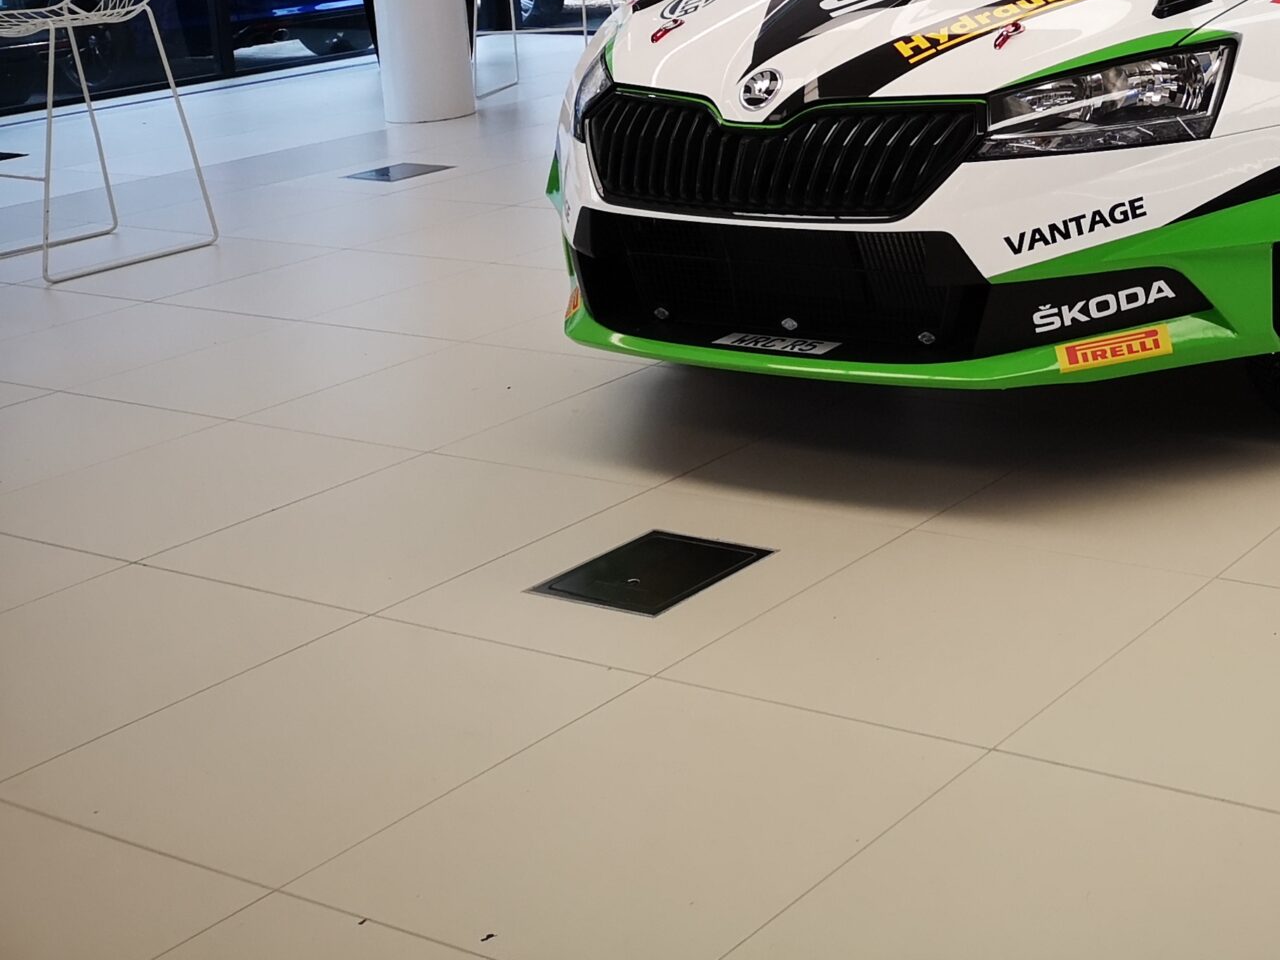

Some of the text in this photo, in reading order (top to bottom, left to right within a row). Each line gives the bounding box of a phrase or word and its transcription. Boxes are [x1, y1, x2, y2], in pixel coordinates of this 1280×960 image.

[1003, 196, 1148, 256] VANTAGE
[1032, 279, 1177, 334] ŠKODA
[783, 340, 825, 352] R5
[1064, 328, 1161, 366] PIRELLI
